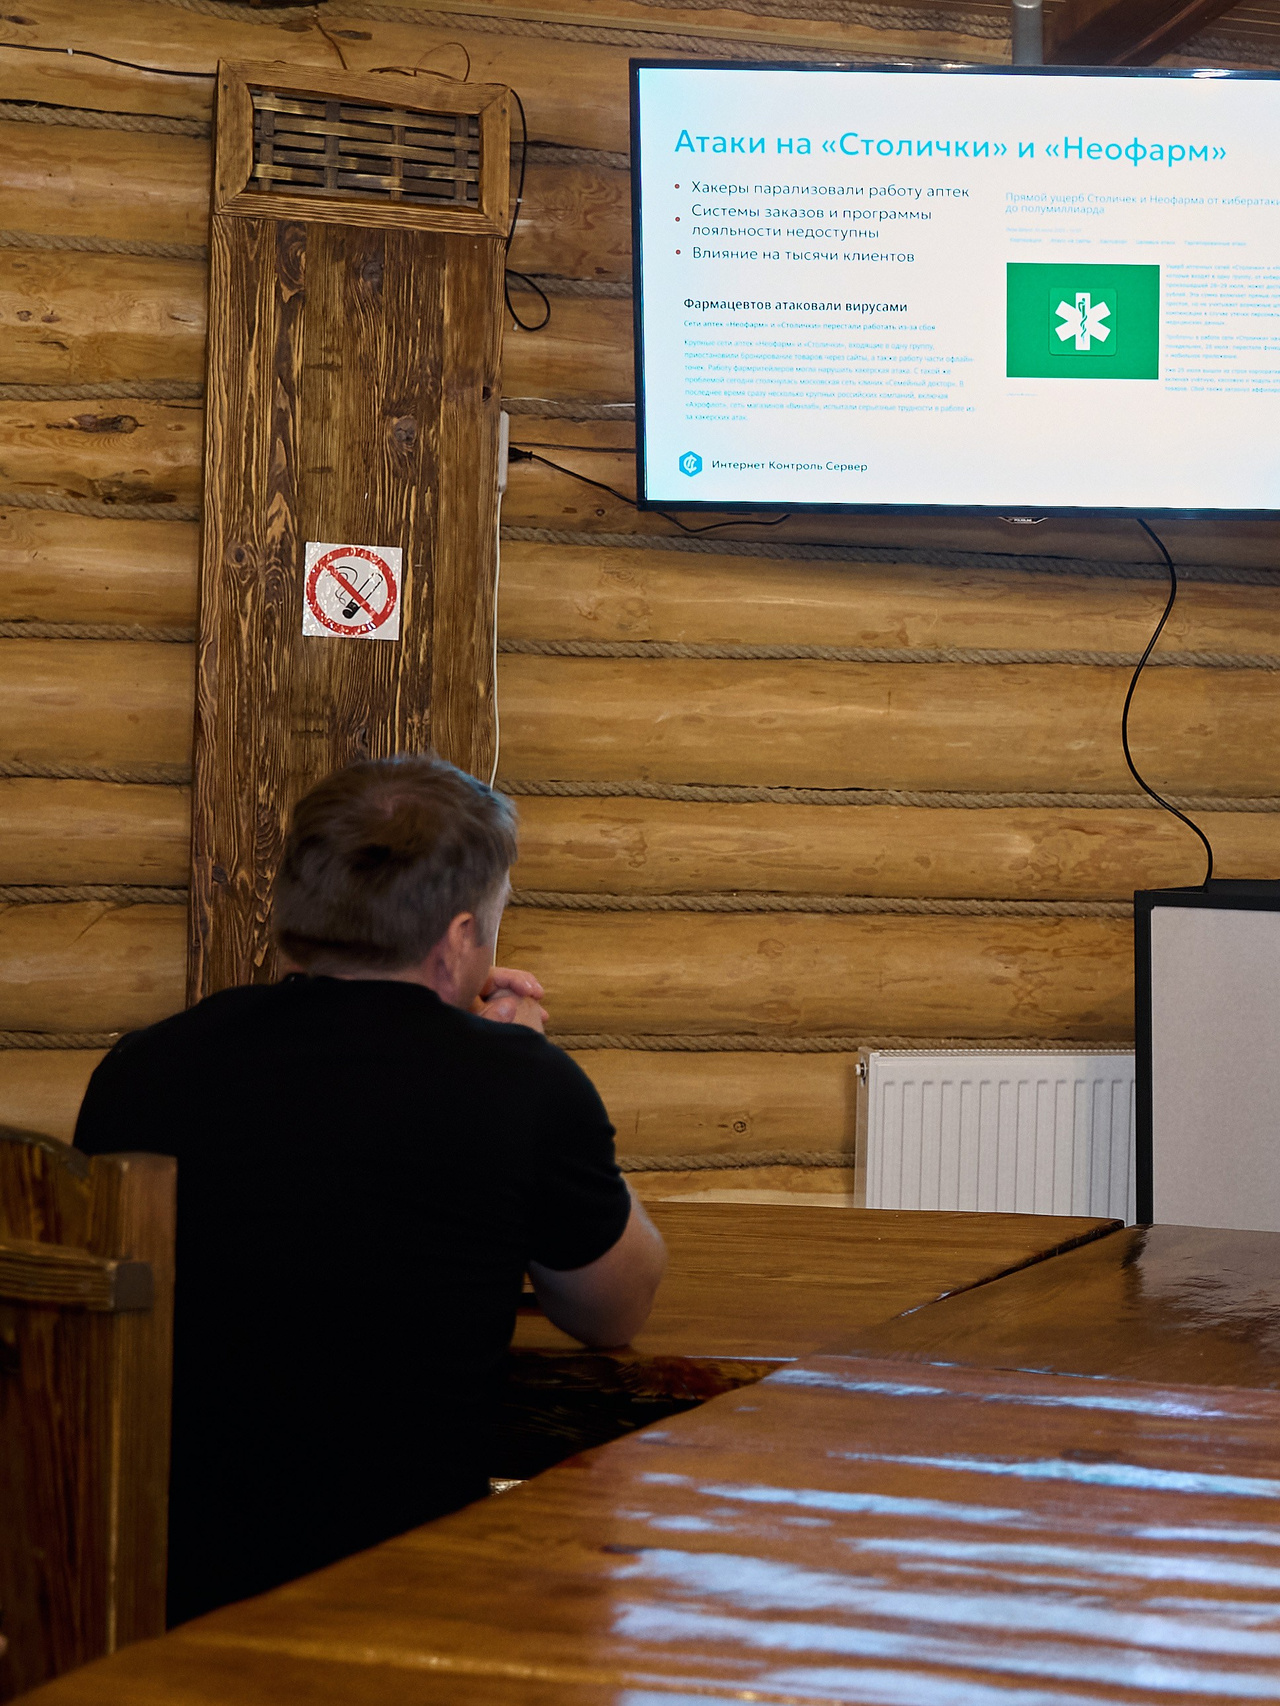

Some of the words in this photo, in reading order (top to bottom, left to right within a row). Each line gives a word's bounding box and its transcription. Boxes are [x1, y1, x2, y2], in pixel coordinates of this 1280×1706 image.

[674, 129, 765, 154] Атаки
[776, 137, 811, 155] на
[821, 132, 1007, 159] «Столички»
[1018, 142, 1034, 159] и
[1045, 136, 1226, 168] «Неофарм»
[691, 180, 748, 196] Хакеры
[754, 183, 863, 198] парализовали
[868, 183, 922, 201] работу
[926, 187, 969, 198] аптек
[1005, 192, 1047, 205] Прямой
[1049, 194, 1084, 207] ущерб
[1086, 194, 1136, 205] Столичек
[1139, 196, 1147, 205] и
[1149, 195, 1204, 207] Неофарма
[1206, 197, 1218, 205] от
[691, 203, 759, 218] Системы
[764, 208, 824, 219] заказов
[829, 210, 837, 218] и
[842, 209, 931, 222] программы
[1004, 204, 1018, 214] до
[1020, 205, 1105, 216] полумиллиарда
[691, 225, 782, 237] лояльности
[786, 228, 878, 242] недоступны
[692, 246, 757, 260] Влияние
[762, 250, 779, 261] на
[785, 251, 838, 261] тысячи
[843, 252, 914, 263] клиентов
[683, 298, 771, 312] Фармацевтов
[774, 301, 841, 311] атаковали
[845, 303, 907, 315] вирусами
[711, 460, 764, 471] Интернет
[768, 461, 822, 471] Контроль
[825, 461, 867, 473] Сервер
